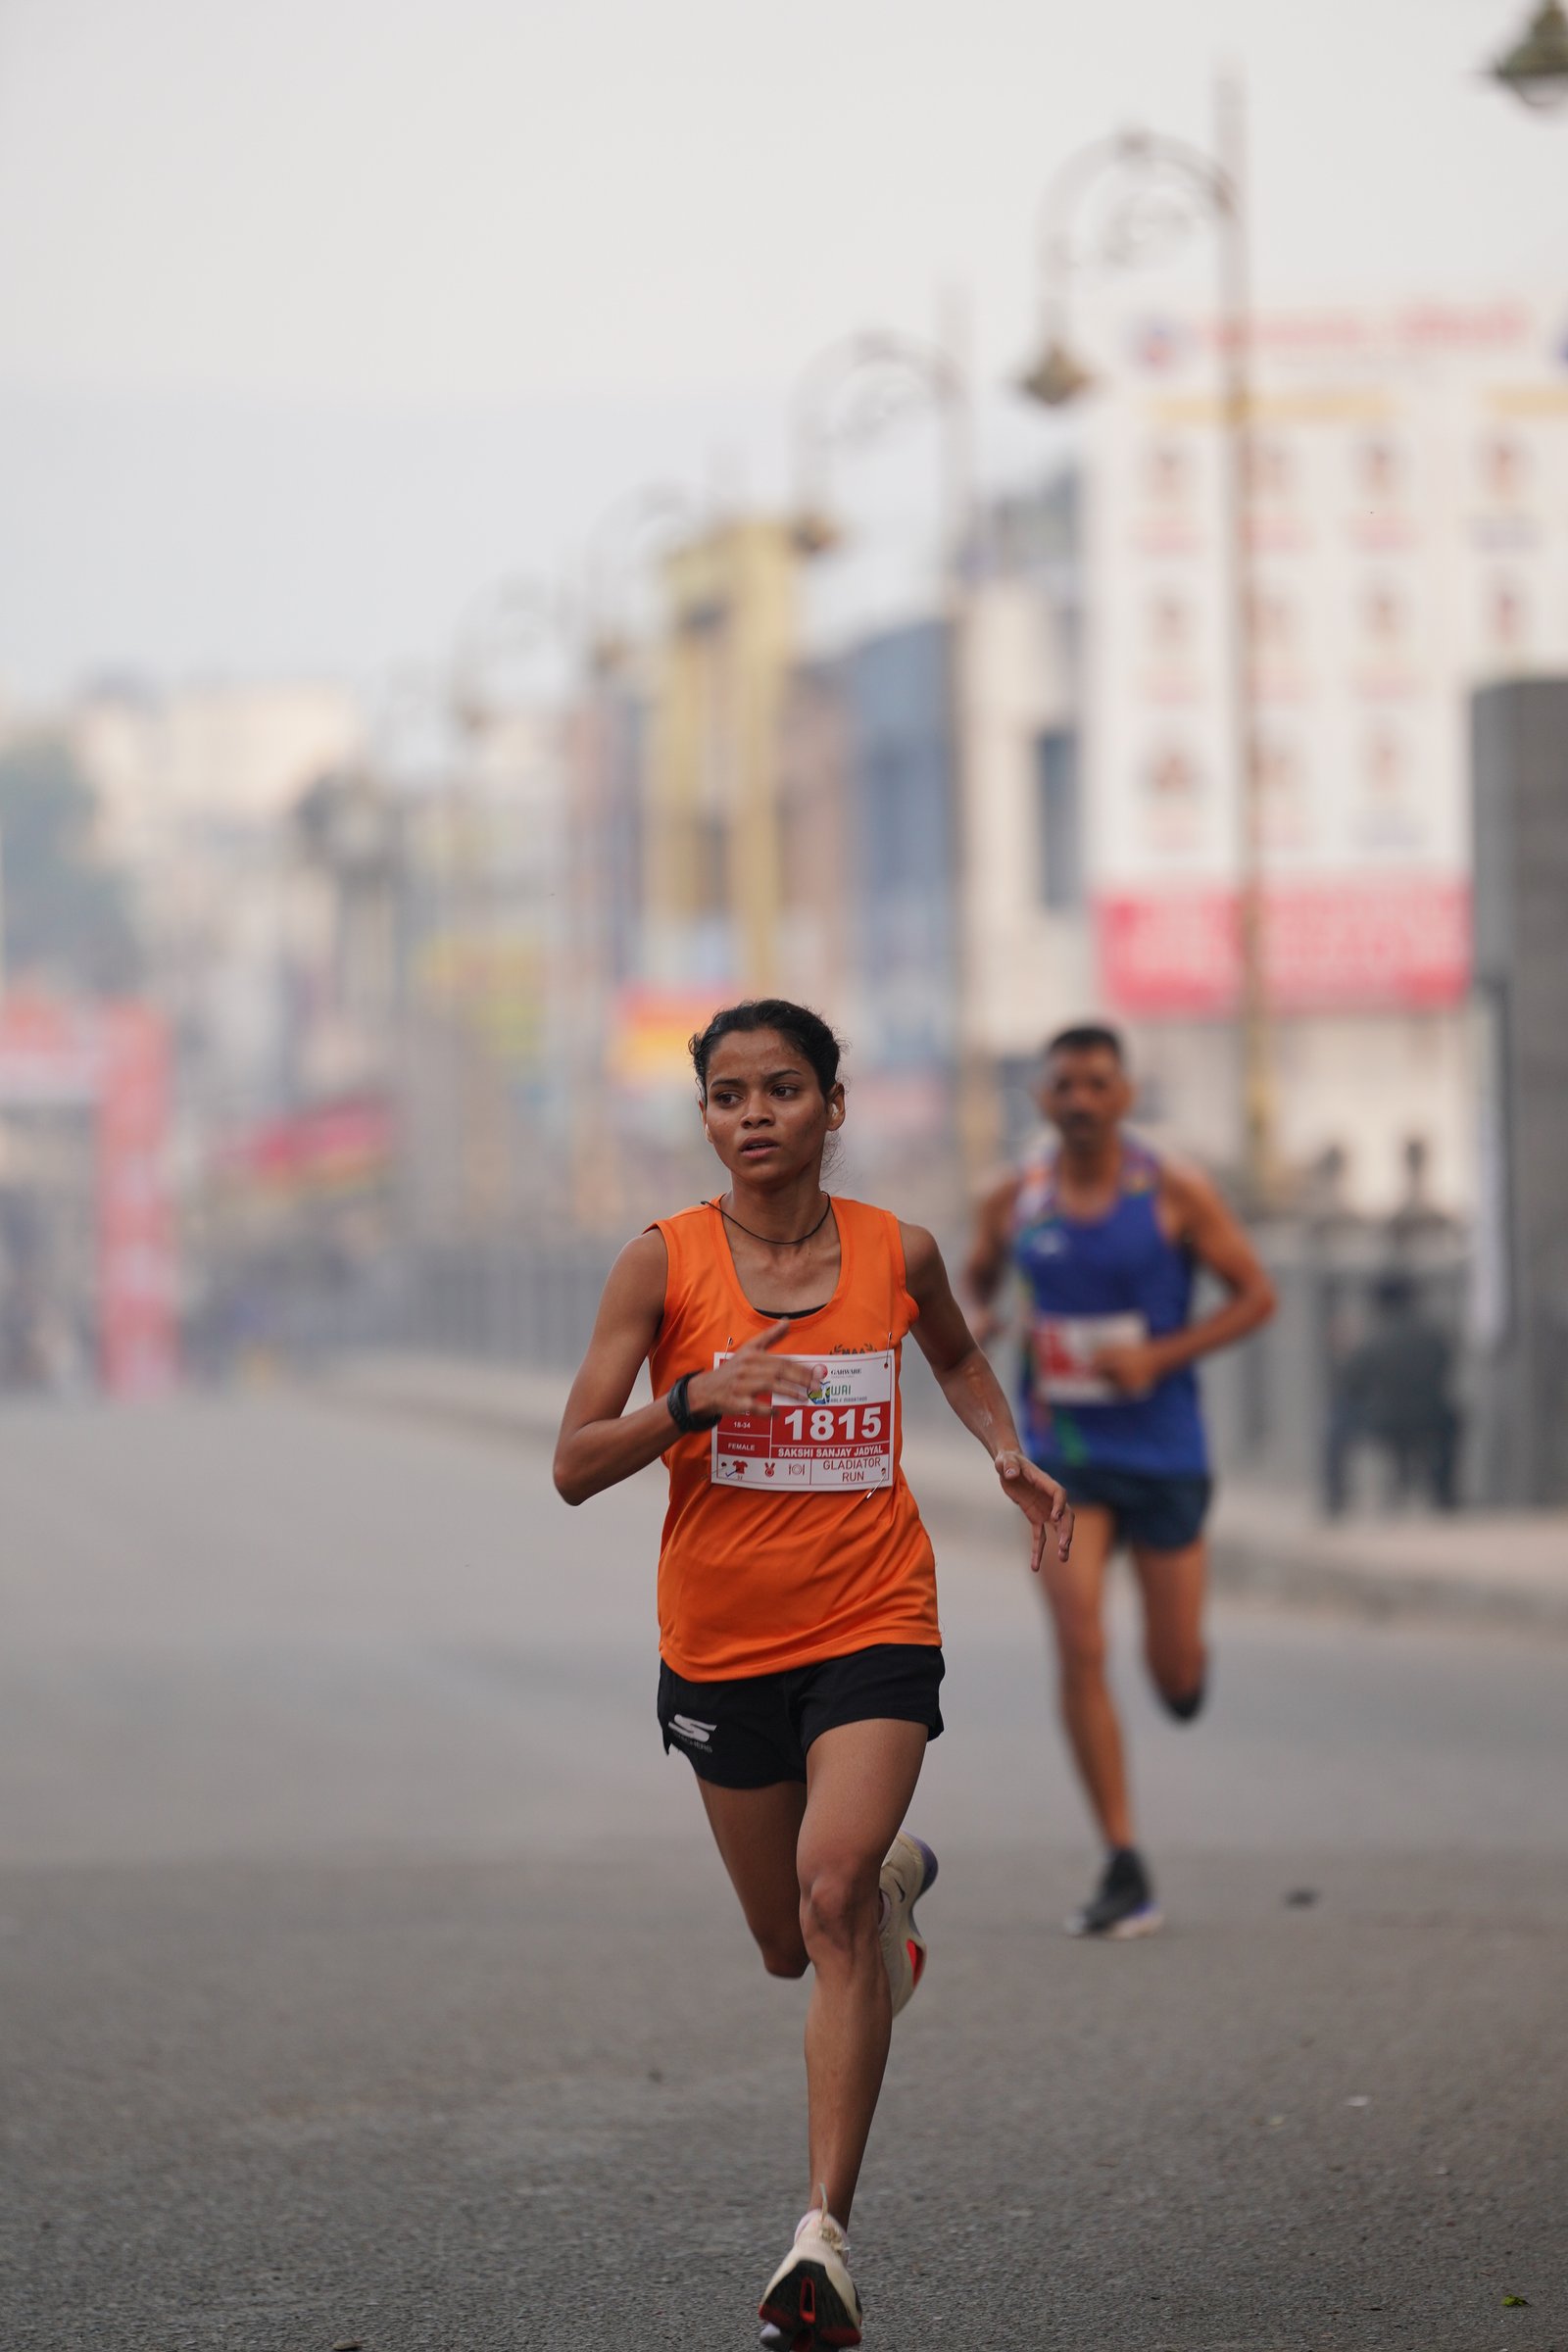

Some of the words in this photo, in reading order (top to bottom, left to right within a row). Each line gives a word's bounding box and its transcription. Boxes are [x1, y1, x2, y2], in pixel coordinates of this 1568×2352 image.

[831, 1384, 851, 1396] WAI
[785, 1407, 881, 1441] 1815
[727, 1442, 756, 1451] FEMALE
[778, 1447, 813, 1458] SAKSHI
[815, 1447, 853, 1457] SANJAY
[854, 1445, 883, 1456] JADYAL
[822, 1456, 881, 1470] GLADIATOR
[842, 1471, 864, 1483] RUN
